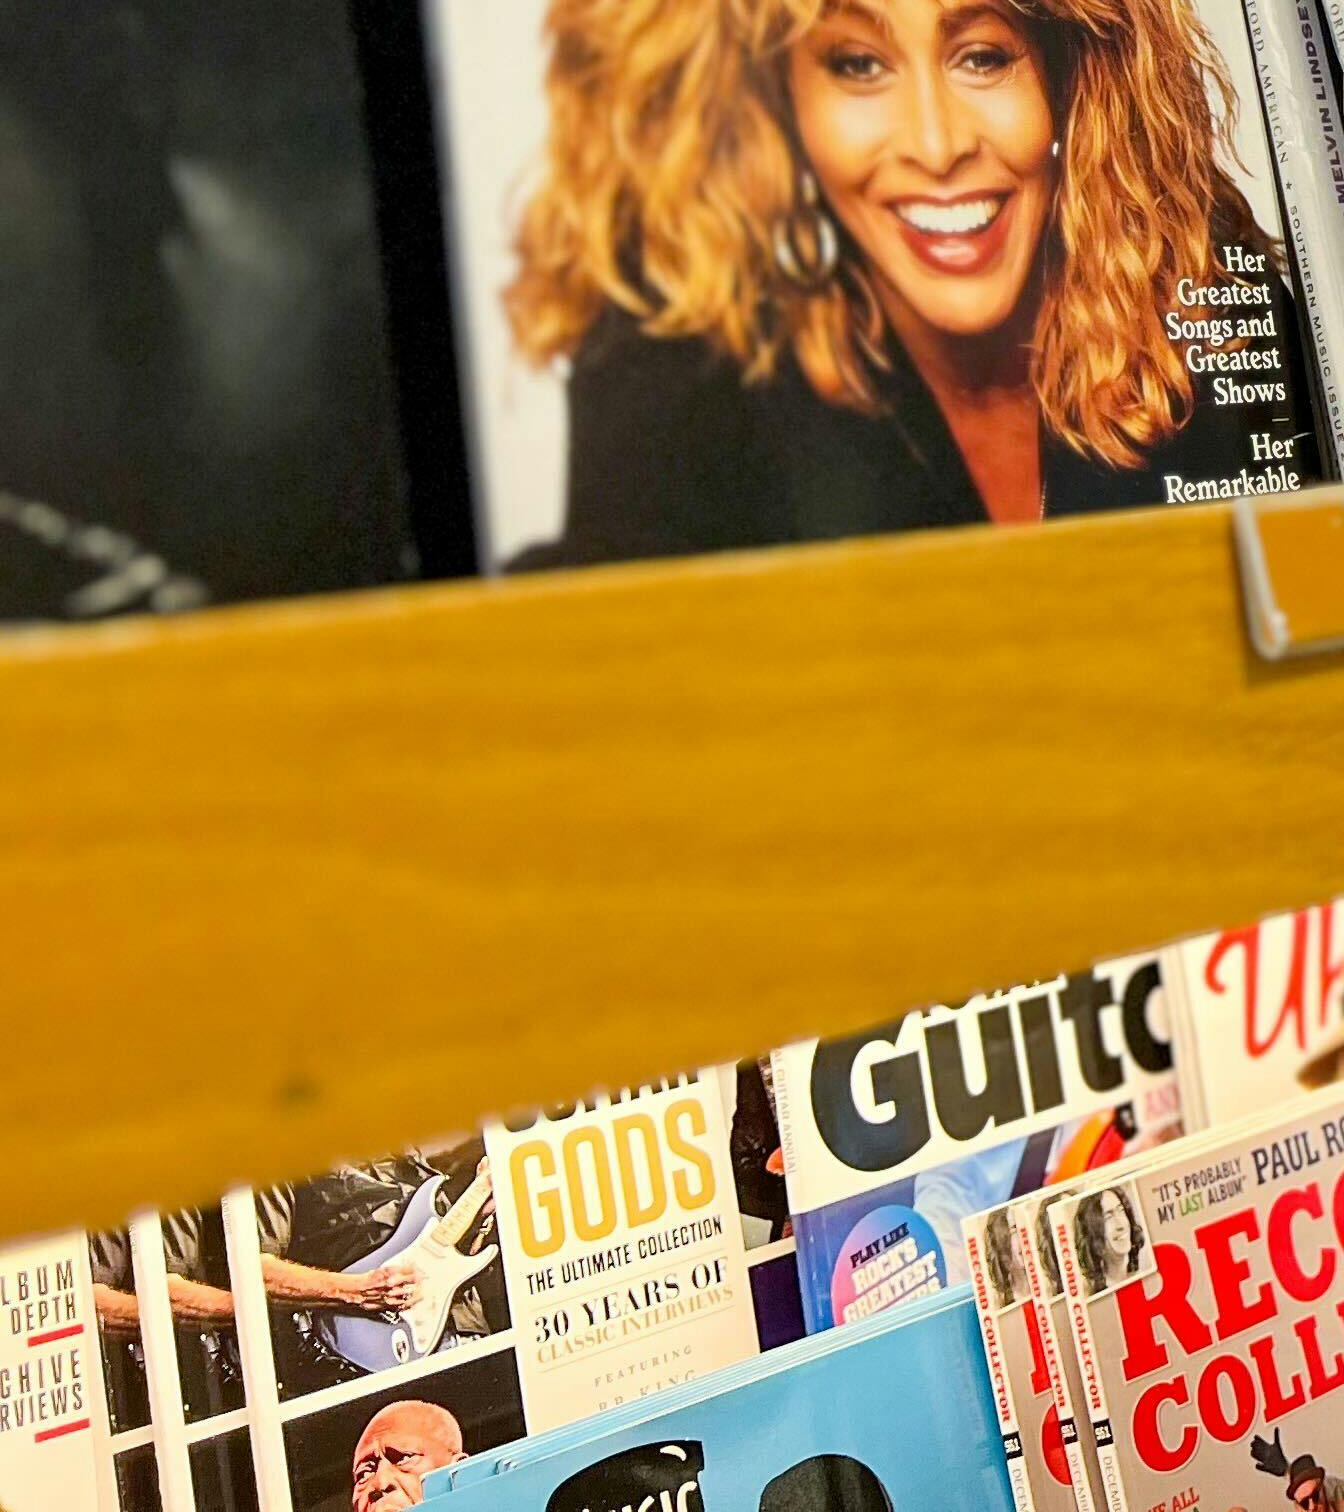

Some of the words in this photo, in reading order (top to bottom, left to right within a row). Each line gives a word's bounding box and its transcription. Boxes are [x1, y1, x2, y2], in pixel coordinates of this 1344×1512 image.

[1258, 62, 1289, 165] AMERICAN
[1290, 205, 1317, 309] SOUTHERN
[1312, 315, 1332, 379] MUSIC
[1222, 245, 1267, 274] Her
[1176, 277, 1272, 308] Greatest
[1165, 311, 1234, 348] Songs
[1236, 310, 1278, 338] and
[1185, 344, 1282, 374] Greatest
[1212, 376, 1287, 407] Shows
[1249, 432, 1295, 462] Her
[1162, 464, 1301, 505] Remarkable
[508, 1096, 717, 1260] GODS
[1183, 1156, 1243, 1194] PROBABLY
[1250, 1129, 1321, 1188] PAUL
[1156, 1204, 1177, 1226] MY
[1177, 1191, 1207, 1218] LAST
[525, 1267, 555, 1296] THE
[560, 1243, 633, 1286] ULTIMATE
[638, 1214, 723, 1260] COLLECTION
[10, 1291, 77, 1336] DEPTH
[534, 1308, 570, 1345] 30
[581, 1272, 682, 1327] YEARS
[691, 1256, 730, 1291] OF
[1019, 1227, 1042, 1305] RECORD
[1037, 1303, 1066, 1409] COLLECTOR
[1055, 1224, 1079, 1303] RECORD
[1072, 1303, 1102, 1410] COLLECTOR
[535, 1323, 618, 1365] CLASSIC
[621, 1285, 735, 1338] INTERVIEWS
[967, 1237, 989, 1314] RECORD
[983, 1315, 1012, 1423] COLLECTOR
[594, 1343, 694, 1388] FEATURING
